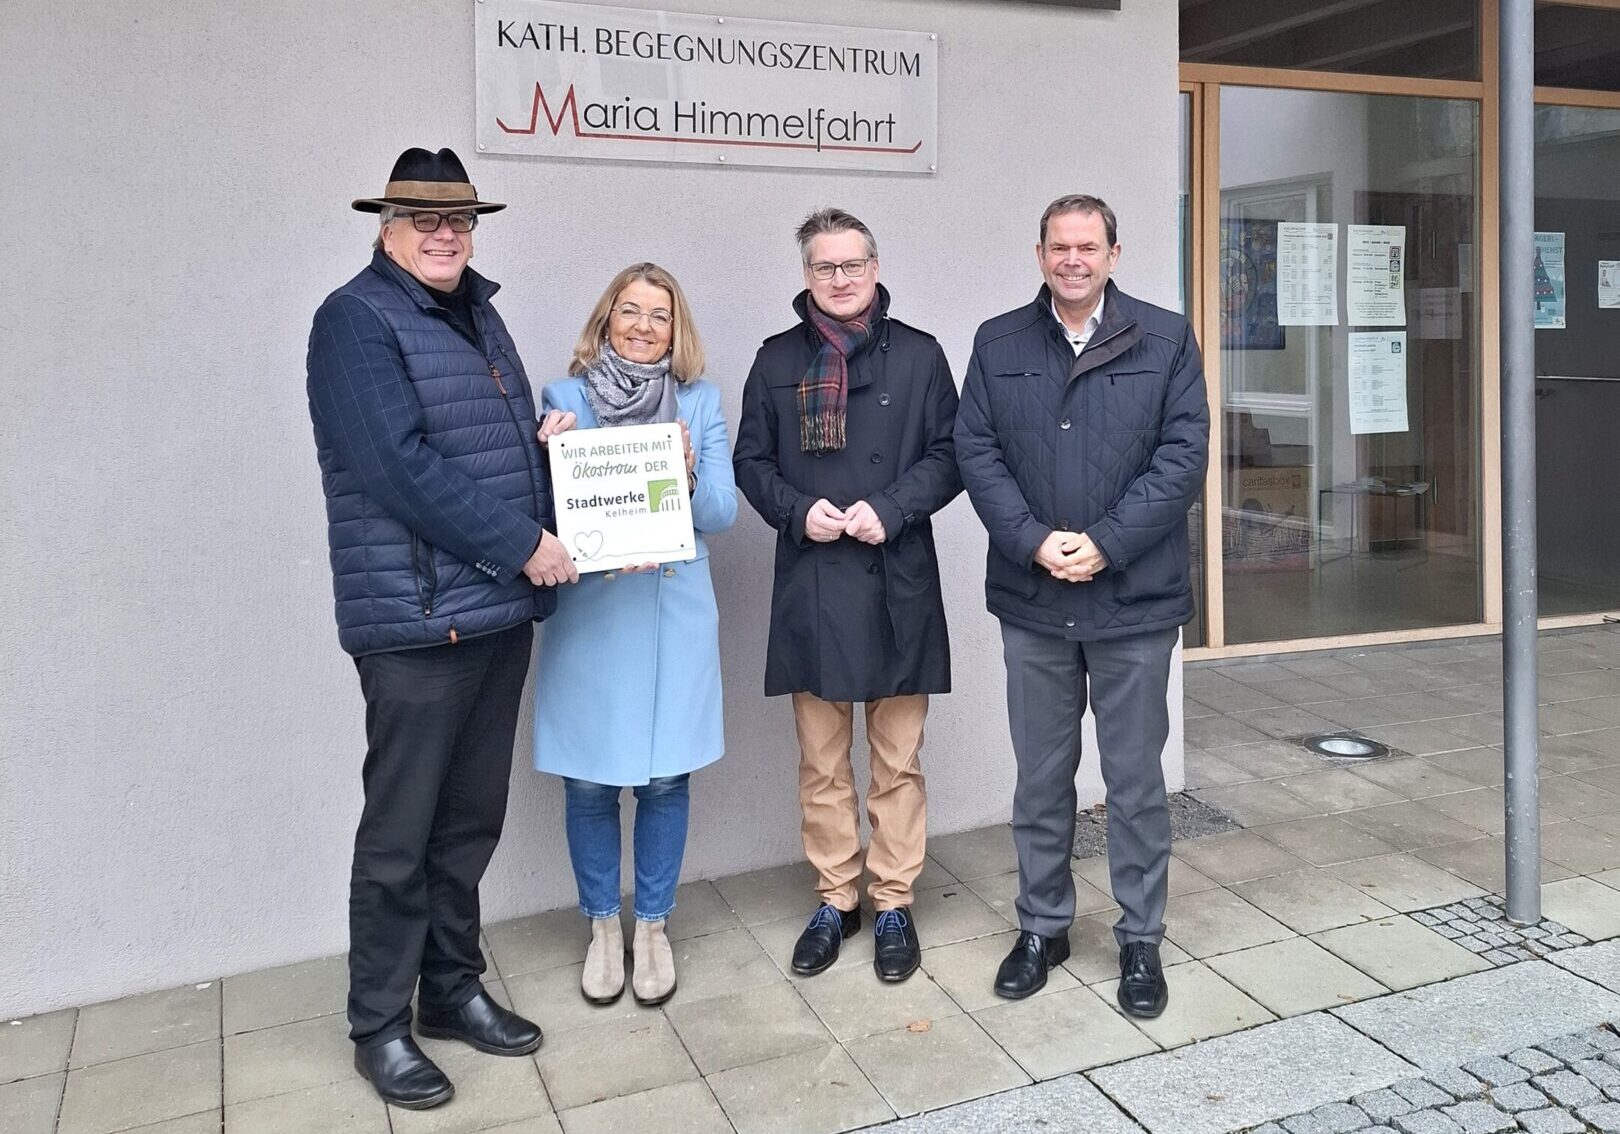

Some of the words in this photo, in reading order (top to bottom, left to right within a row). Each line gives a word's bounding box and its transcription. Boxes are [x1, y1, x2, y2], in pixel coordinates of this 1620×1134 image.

[497, 19, 586, 54] KATH.
[595, 27, 920, 78] BEGEGNUNGSZENTRUM
[530, 81, 661, 136] Maria
[674, 100, 896, 152] Himmelfahrt
[561, 447, 587, 460] WIR
[589, 442, 649, 458] ARBEITEN
[651, 439, 673, 452] MIT
[572, 460, 638, 480] Ökostrom
[644, 460, 669, 473] DER
[1242, 475, 1290, 489] caritasbox
[566, 491, 645, 510] Stadtwerke
[605, 507, 647, 518] Kelheim
